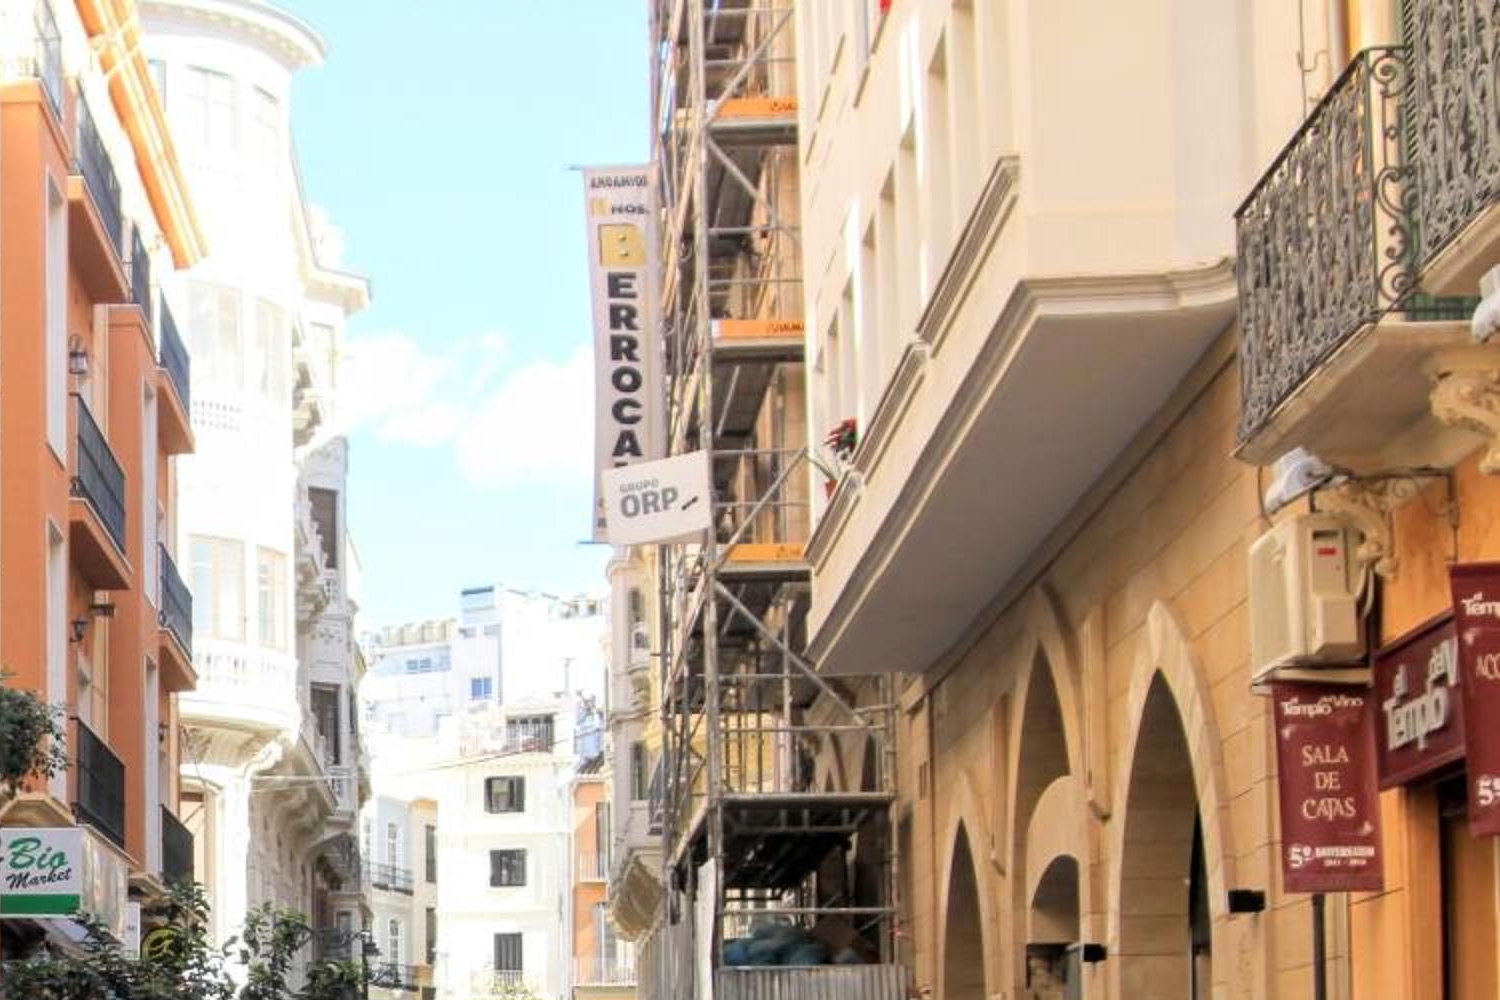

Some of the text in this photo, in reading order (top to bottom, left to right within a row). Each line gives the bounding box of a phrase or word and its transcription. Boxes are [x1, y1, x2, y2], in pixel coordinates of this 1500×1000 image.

[598, 223, 644, 467] BERROCA
[619, 478, 659, 493] GRUPO
[620, 487, 679, 518] ORP
[1280, 699, 1332, 718] Templo
[1382, 672, 1448, 751] Templo
[1301, 744, 1349, 767] SALA
[1315, 771, 1341, 790] DE
[7, 836, 69, 870] Bio
[5, 866, 72, 890] Market
